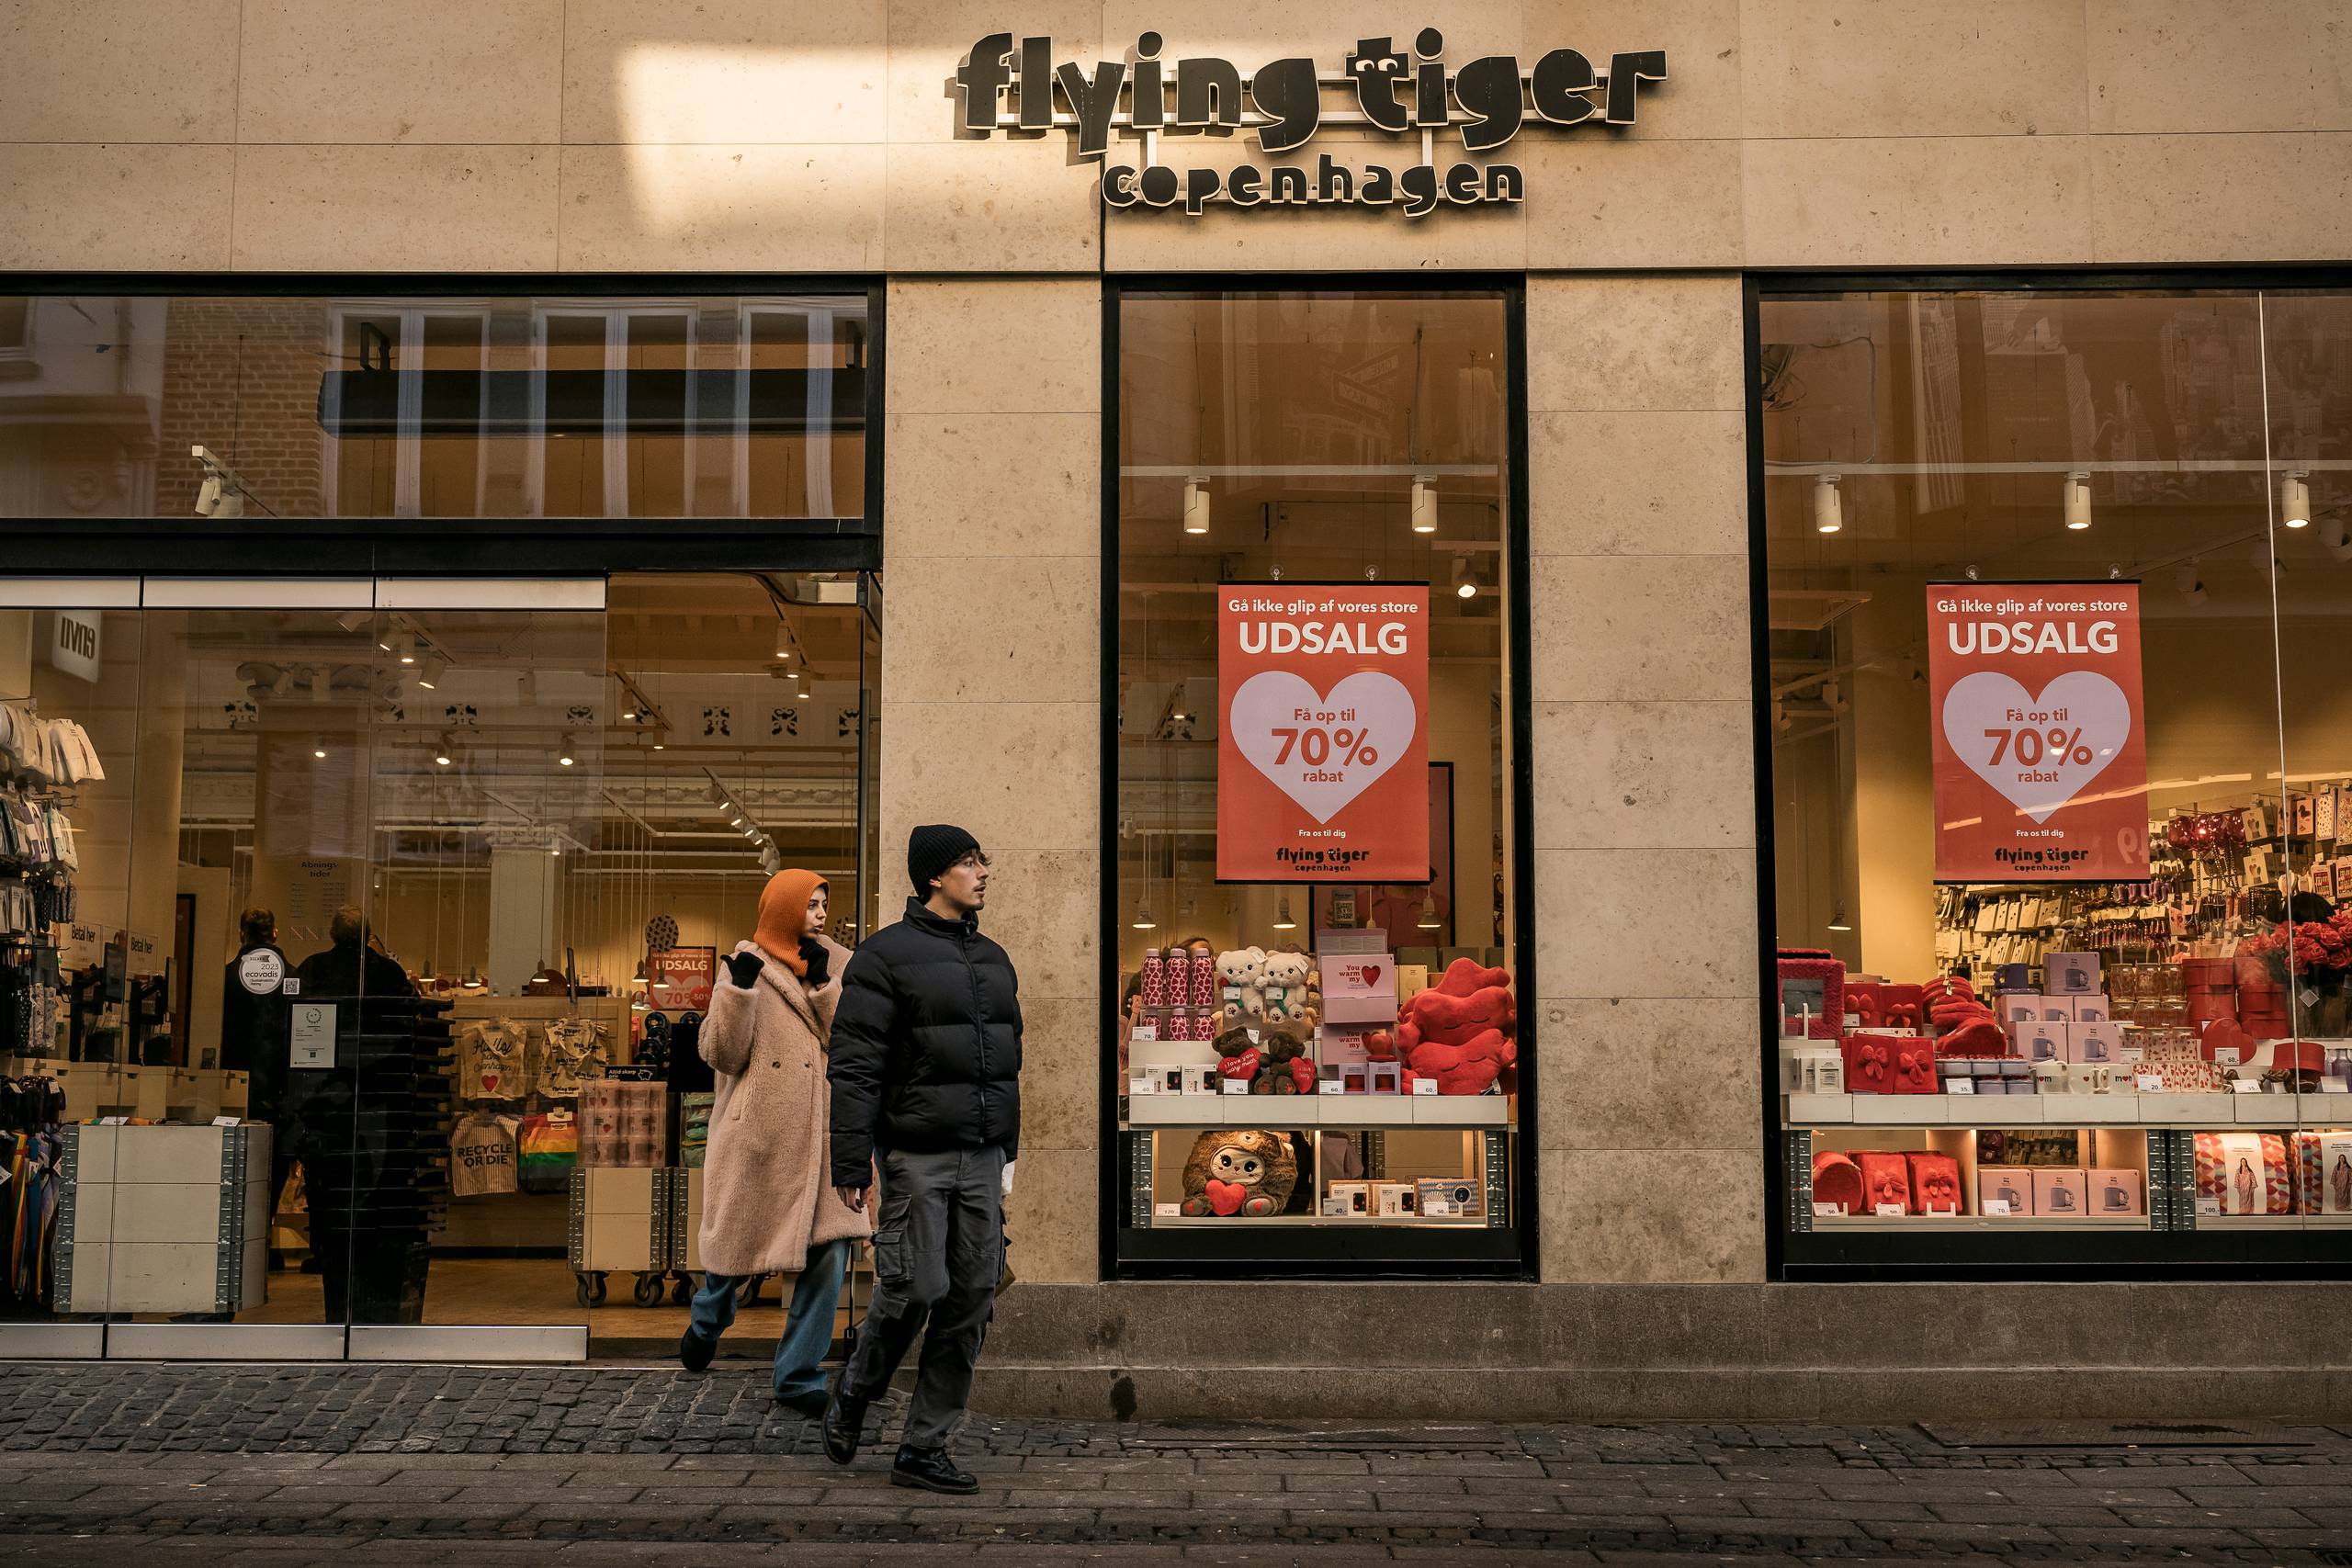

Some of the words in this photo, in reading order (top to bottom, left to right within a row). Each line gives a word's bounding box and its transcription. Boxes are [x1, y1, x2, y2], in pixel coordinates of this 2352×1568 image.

[956, 31, 1322, 156] flying
[1344, 27, 1668, 152] tiger
[1102, 153, 1524, 219] copenhagen
[1228, 599, 1249, 612] Gå
[1253, 600, 1283, 612] ikke
[1287, 600, 1316, 615] glip
[1319, 600, 1334, 613] af
[1338, 603, 1377, 613] vores
[1381, 602, 1418, 613] store
[1937, 600, 1957, 613] Gå
[1961, 600, 1993, 613] ikke
[1996, 600, 2024, 615] glip
[2028, 599, 2043, 612] af
[2046, 602, 2086, 612] vores
[2089, 601, 2128, 612] store
[1239, 622, 1408, 655] UDSALG
[1949, 621, 2118, 655] UDSALG
[1295, 708, 1311, 721] Få
[1316, 713, 1336, 725] op
[1340, 708, 1355, 721] til
[2007, 708, 2023, 721] Få
[2029, 712, 2048, 725] op
[2052, 708, 2068, 721] til
[1271, 728, 1378, 766] 70%
[1984, 728, 2093, 766] 70%
[1303, 770, 1344, 782] rabat
[2018, 770, 2059, 783] rabat
[1333, 829, 1346, 838] dig
[2051, 829, 2064, 838] dig
[1276, 848, 1324, 863] flying
[1327, 848, 1369, 863] tiger
[1995, 848, 2043, 864] flying
[2045, 848, 2088, 863] tiger
[1295, 864, 1351, 873] copenhagen
[2014, 864, 2071, 873] copenhagen
[86, 926, 96, 942] her
[145, 938, 153, 953] her
[656, 960, 708, 971] UDSALG
[1242, 1053, 1253, 1062] you
[458, 1144, 513, 1157] RECYCLE
[464, 1156, 482, 1167] OR
[486, 1155, 508, 1165] DIE
